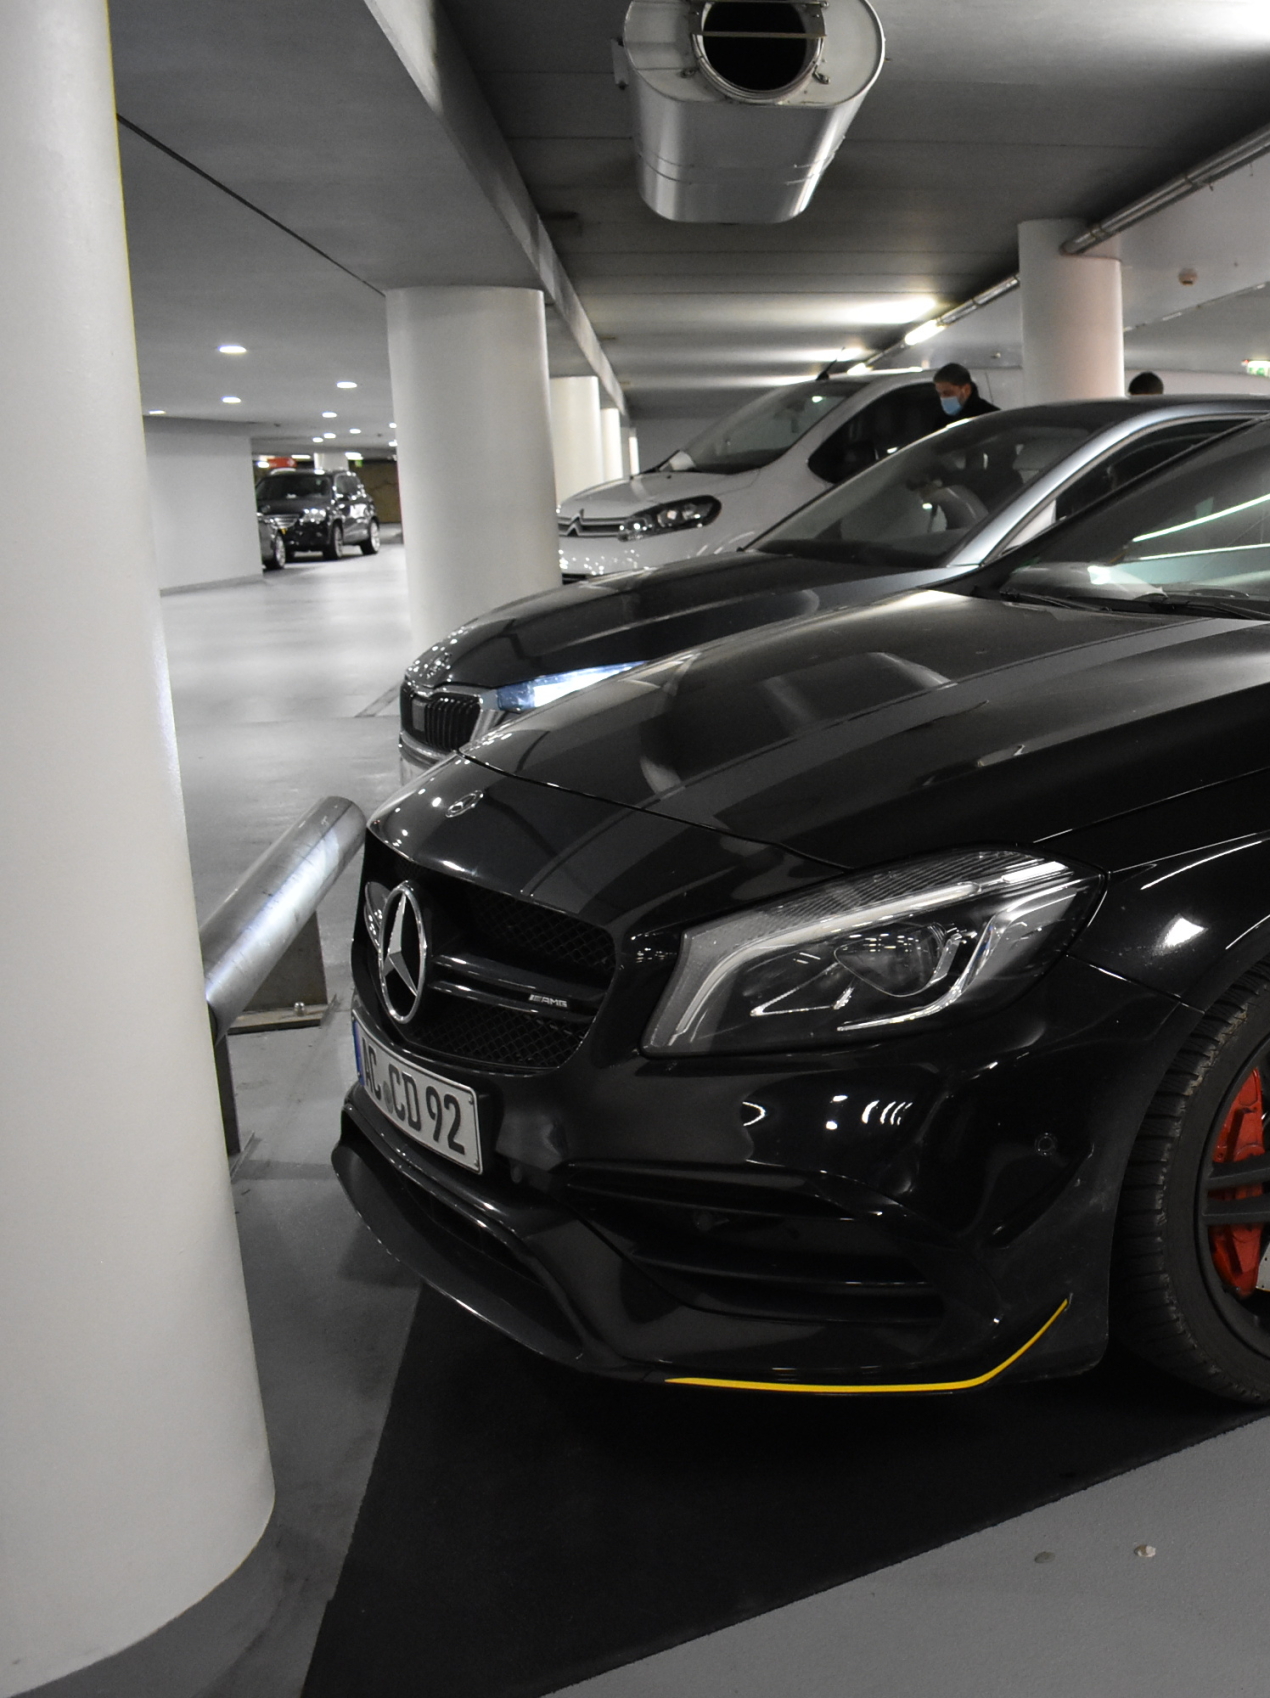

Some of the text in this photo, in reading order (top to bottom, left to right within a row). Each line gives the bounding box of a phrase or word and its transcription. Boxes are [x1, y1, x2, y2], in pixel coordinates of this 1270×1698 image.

[541, 996, 568, 1008] AMG
[388, 1064, 422, 1132] CD
[425, 1085, 466, 1156] 92
